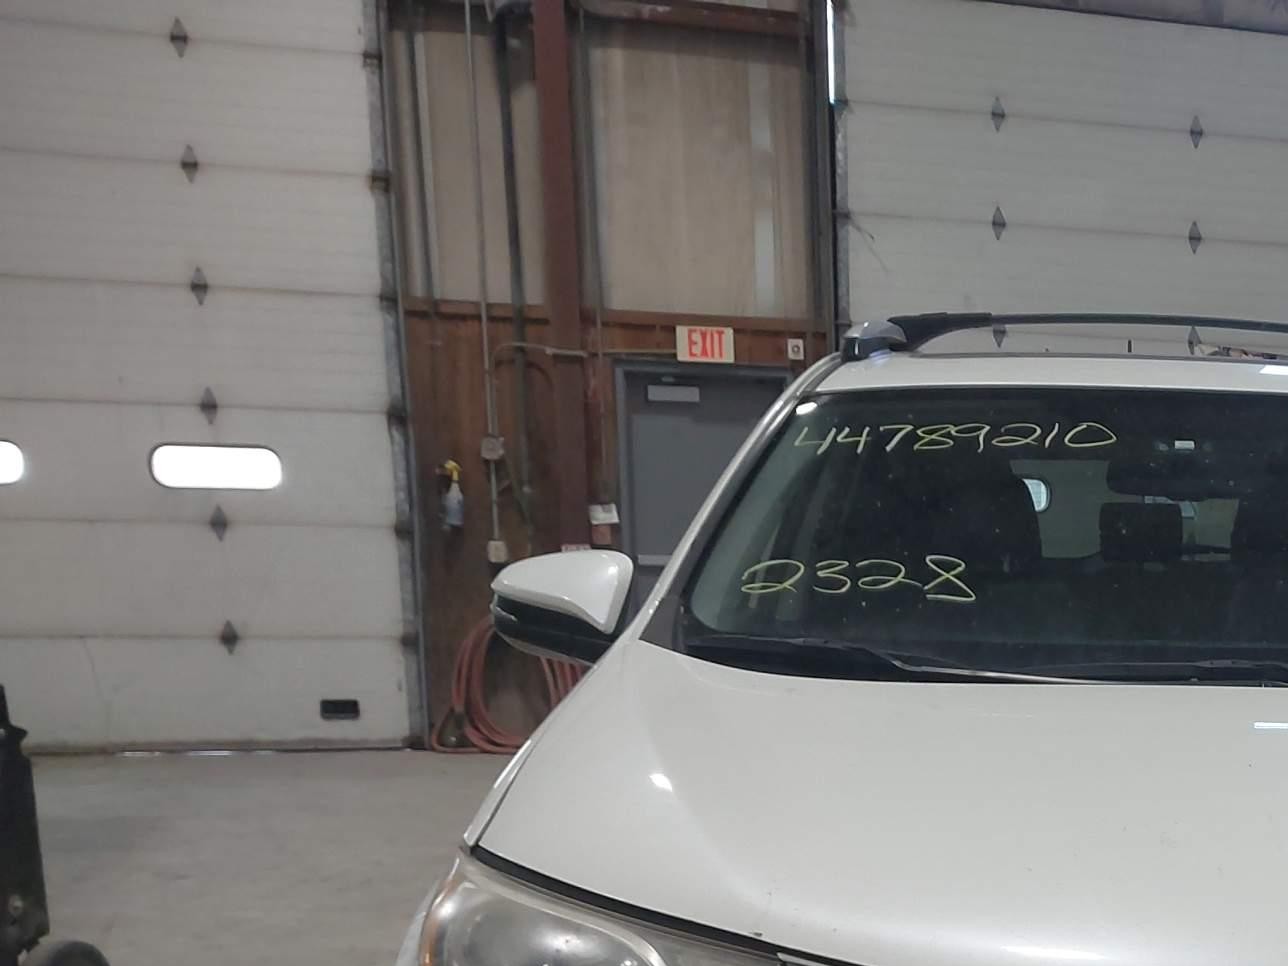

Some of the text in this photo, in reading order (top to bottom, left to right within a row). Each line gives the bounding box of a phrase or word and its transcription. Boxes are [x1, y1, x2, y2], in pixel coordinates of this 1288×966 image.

[687, 327, 725, 360] EXIT
[794, 422, 1117, 454] 44789210
[740, 554, 977, 602] 2328
